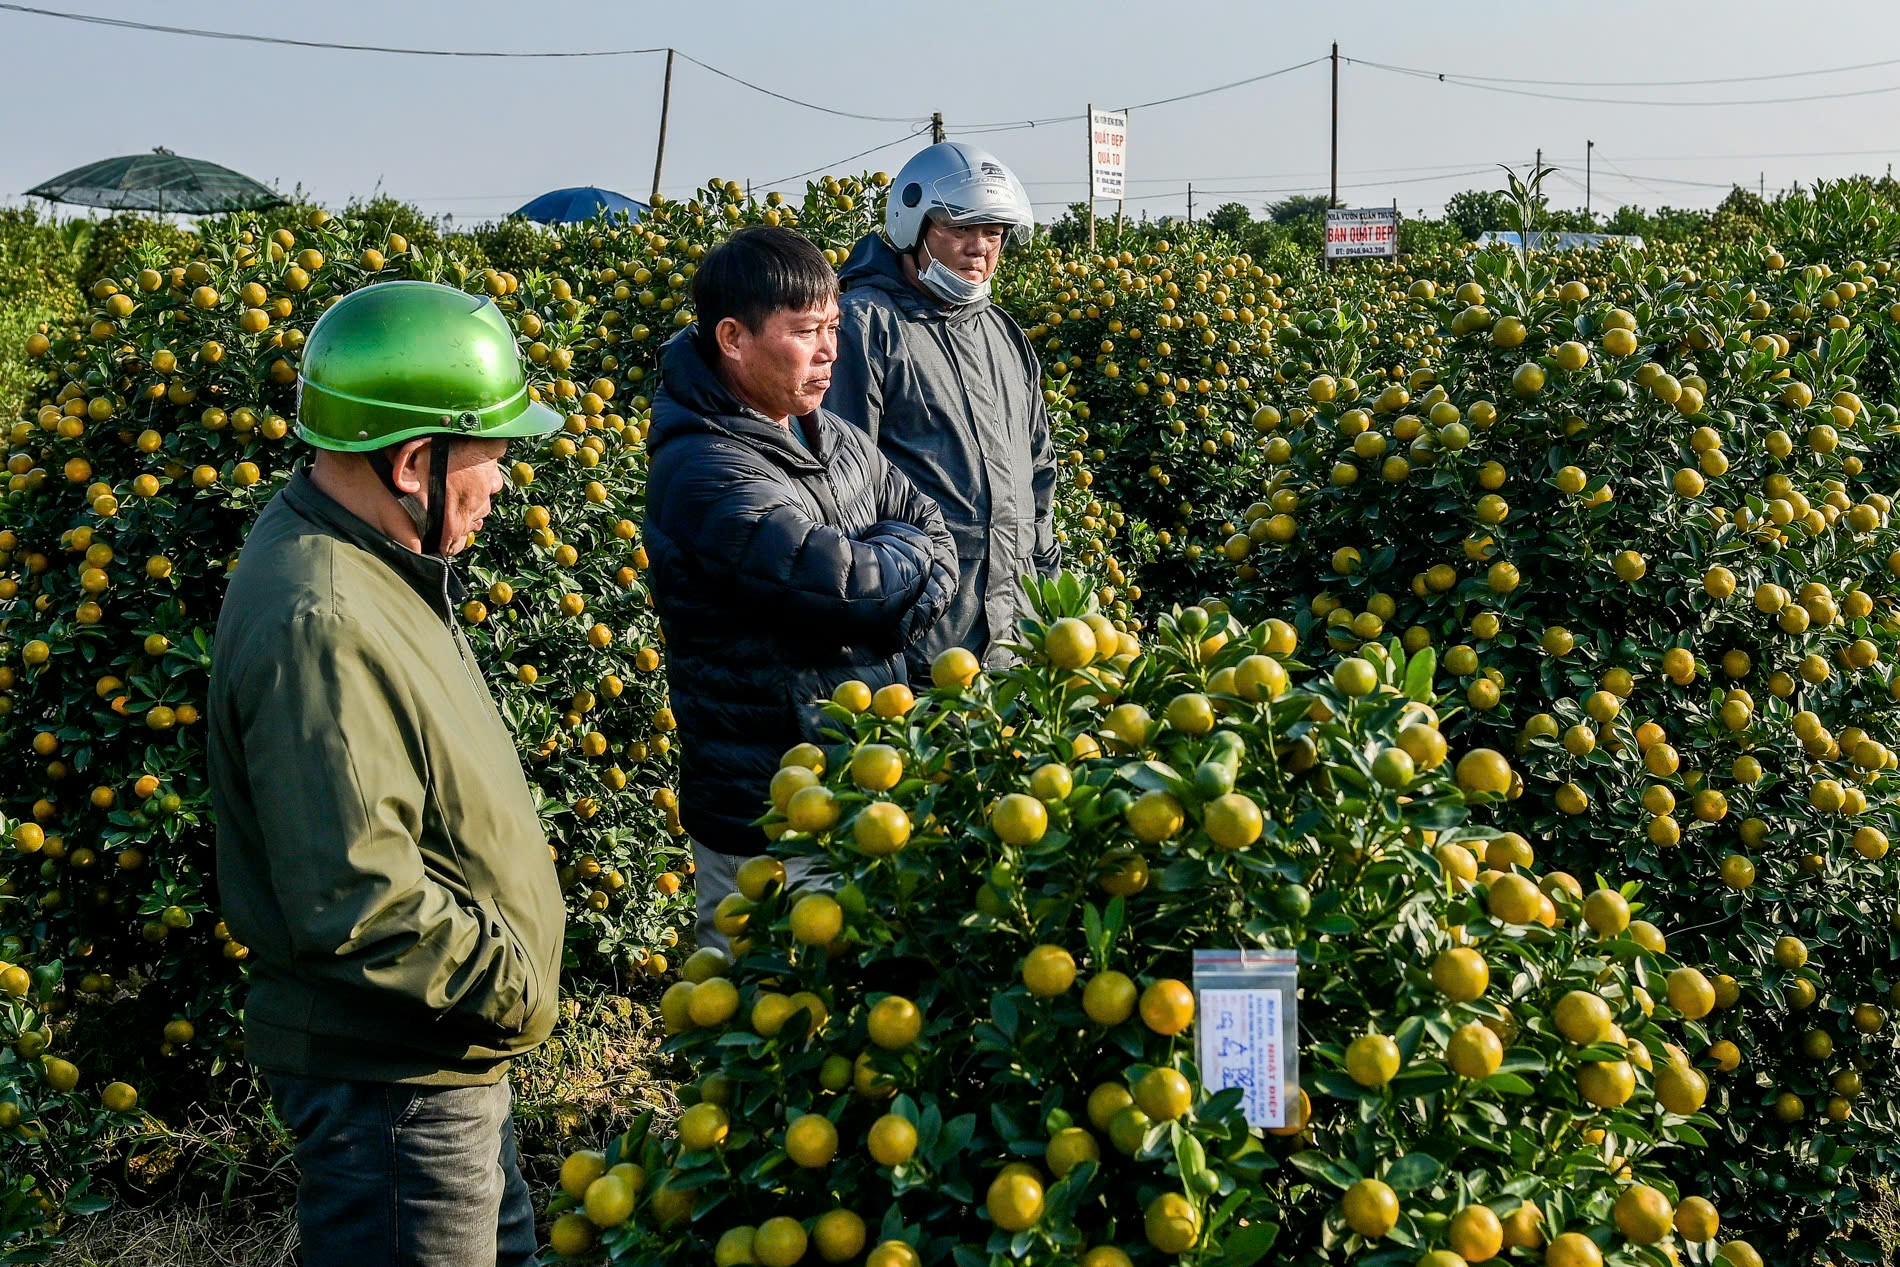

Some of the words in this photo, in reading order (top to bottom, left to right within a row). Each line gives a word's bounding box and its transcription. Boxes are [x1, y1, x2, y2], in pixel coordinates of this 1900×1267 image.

[1112, 153, 1120, 166] TO
[1328, 223, 1347, 242] BÁN
[1350, 223, 1374, 243] QUẤT
[1375, 226, 1393, 244] ĐẸP
